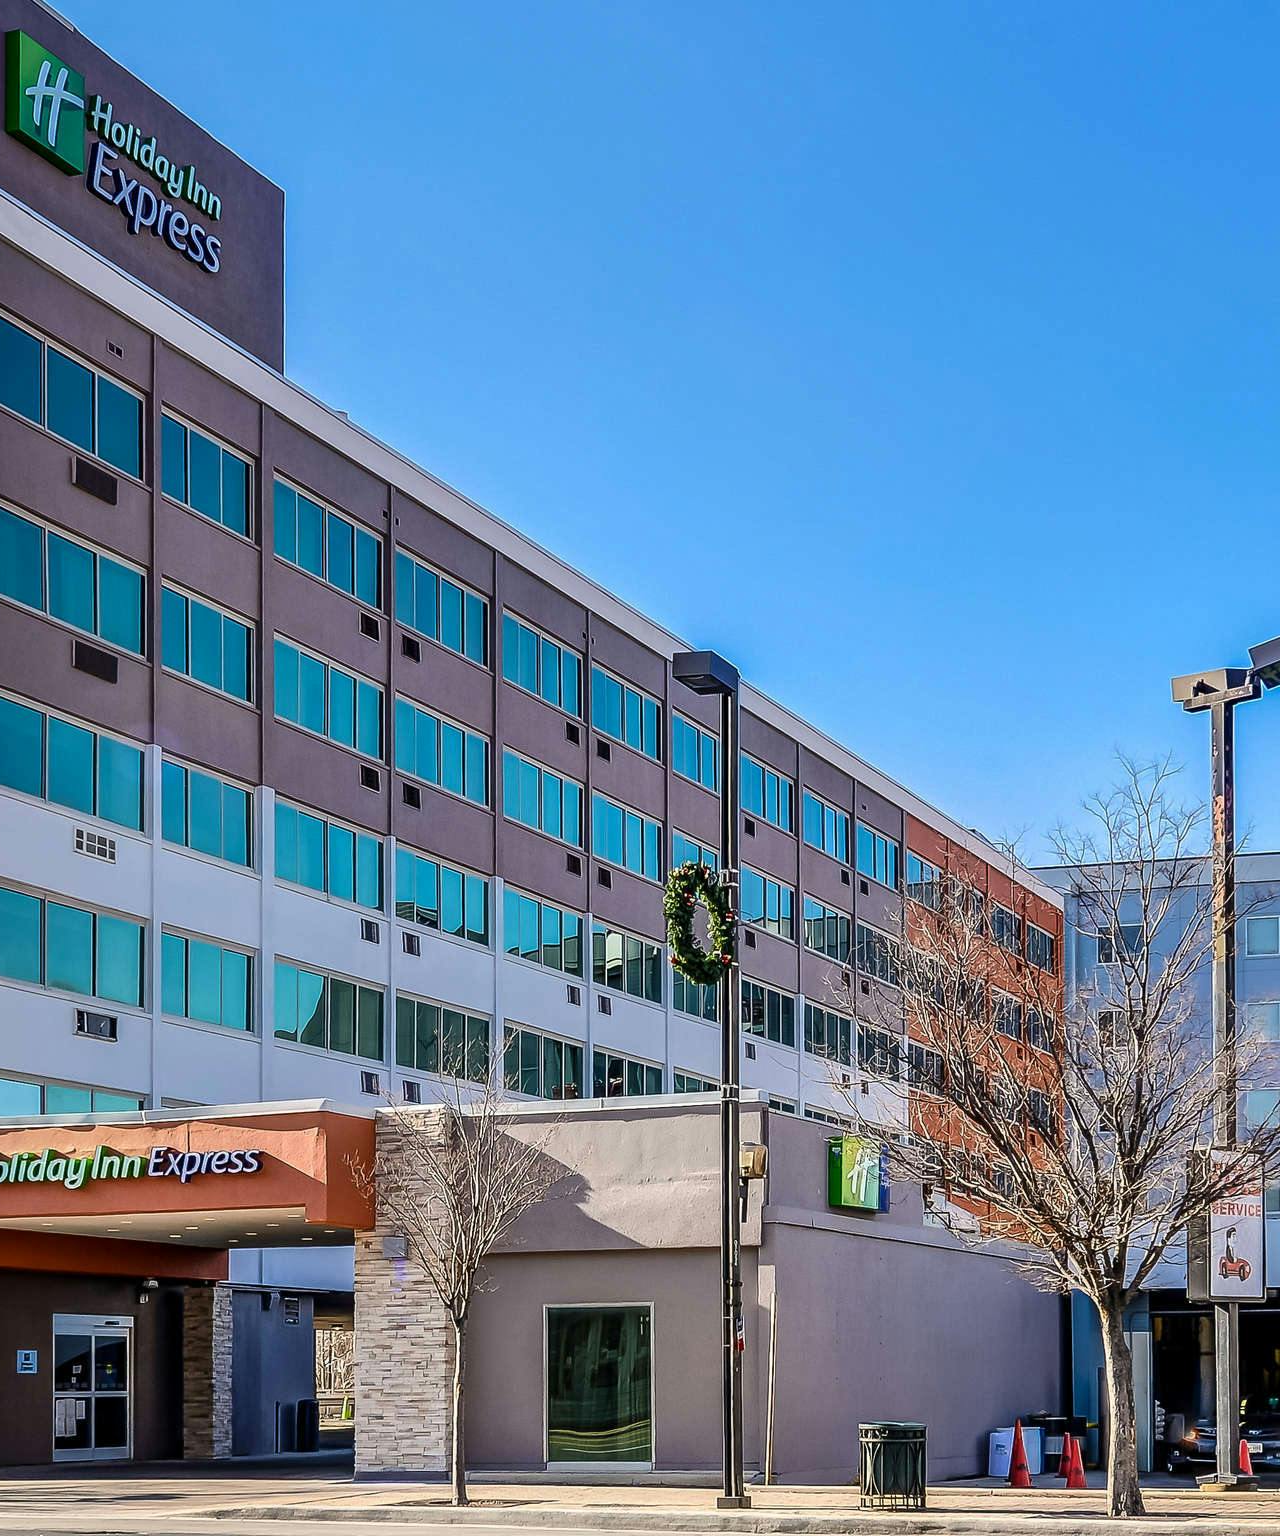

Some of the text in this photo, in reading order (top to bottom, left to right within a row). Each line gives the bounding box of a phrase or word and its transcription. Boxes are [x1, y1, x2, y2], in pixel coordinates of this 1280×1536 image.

[89, 95, 221, 221] Holiday Inn
[88, 142, 221, 273] Express
[91, 1145, 145, 1179] Inn
[147, 1146, 263, 1183] Express
[1211, 1201, 1261, 1217] SERVICE
